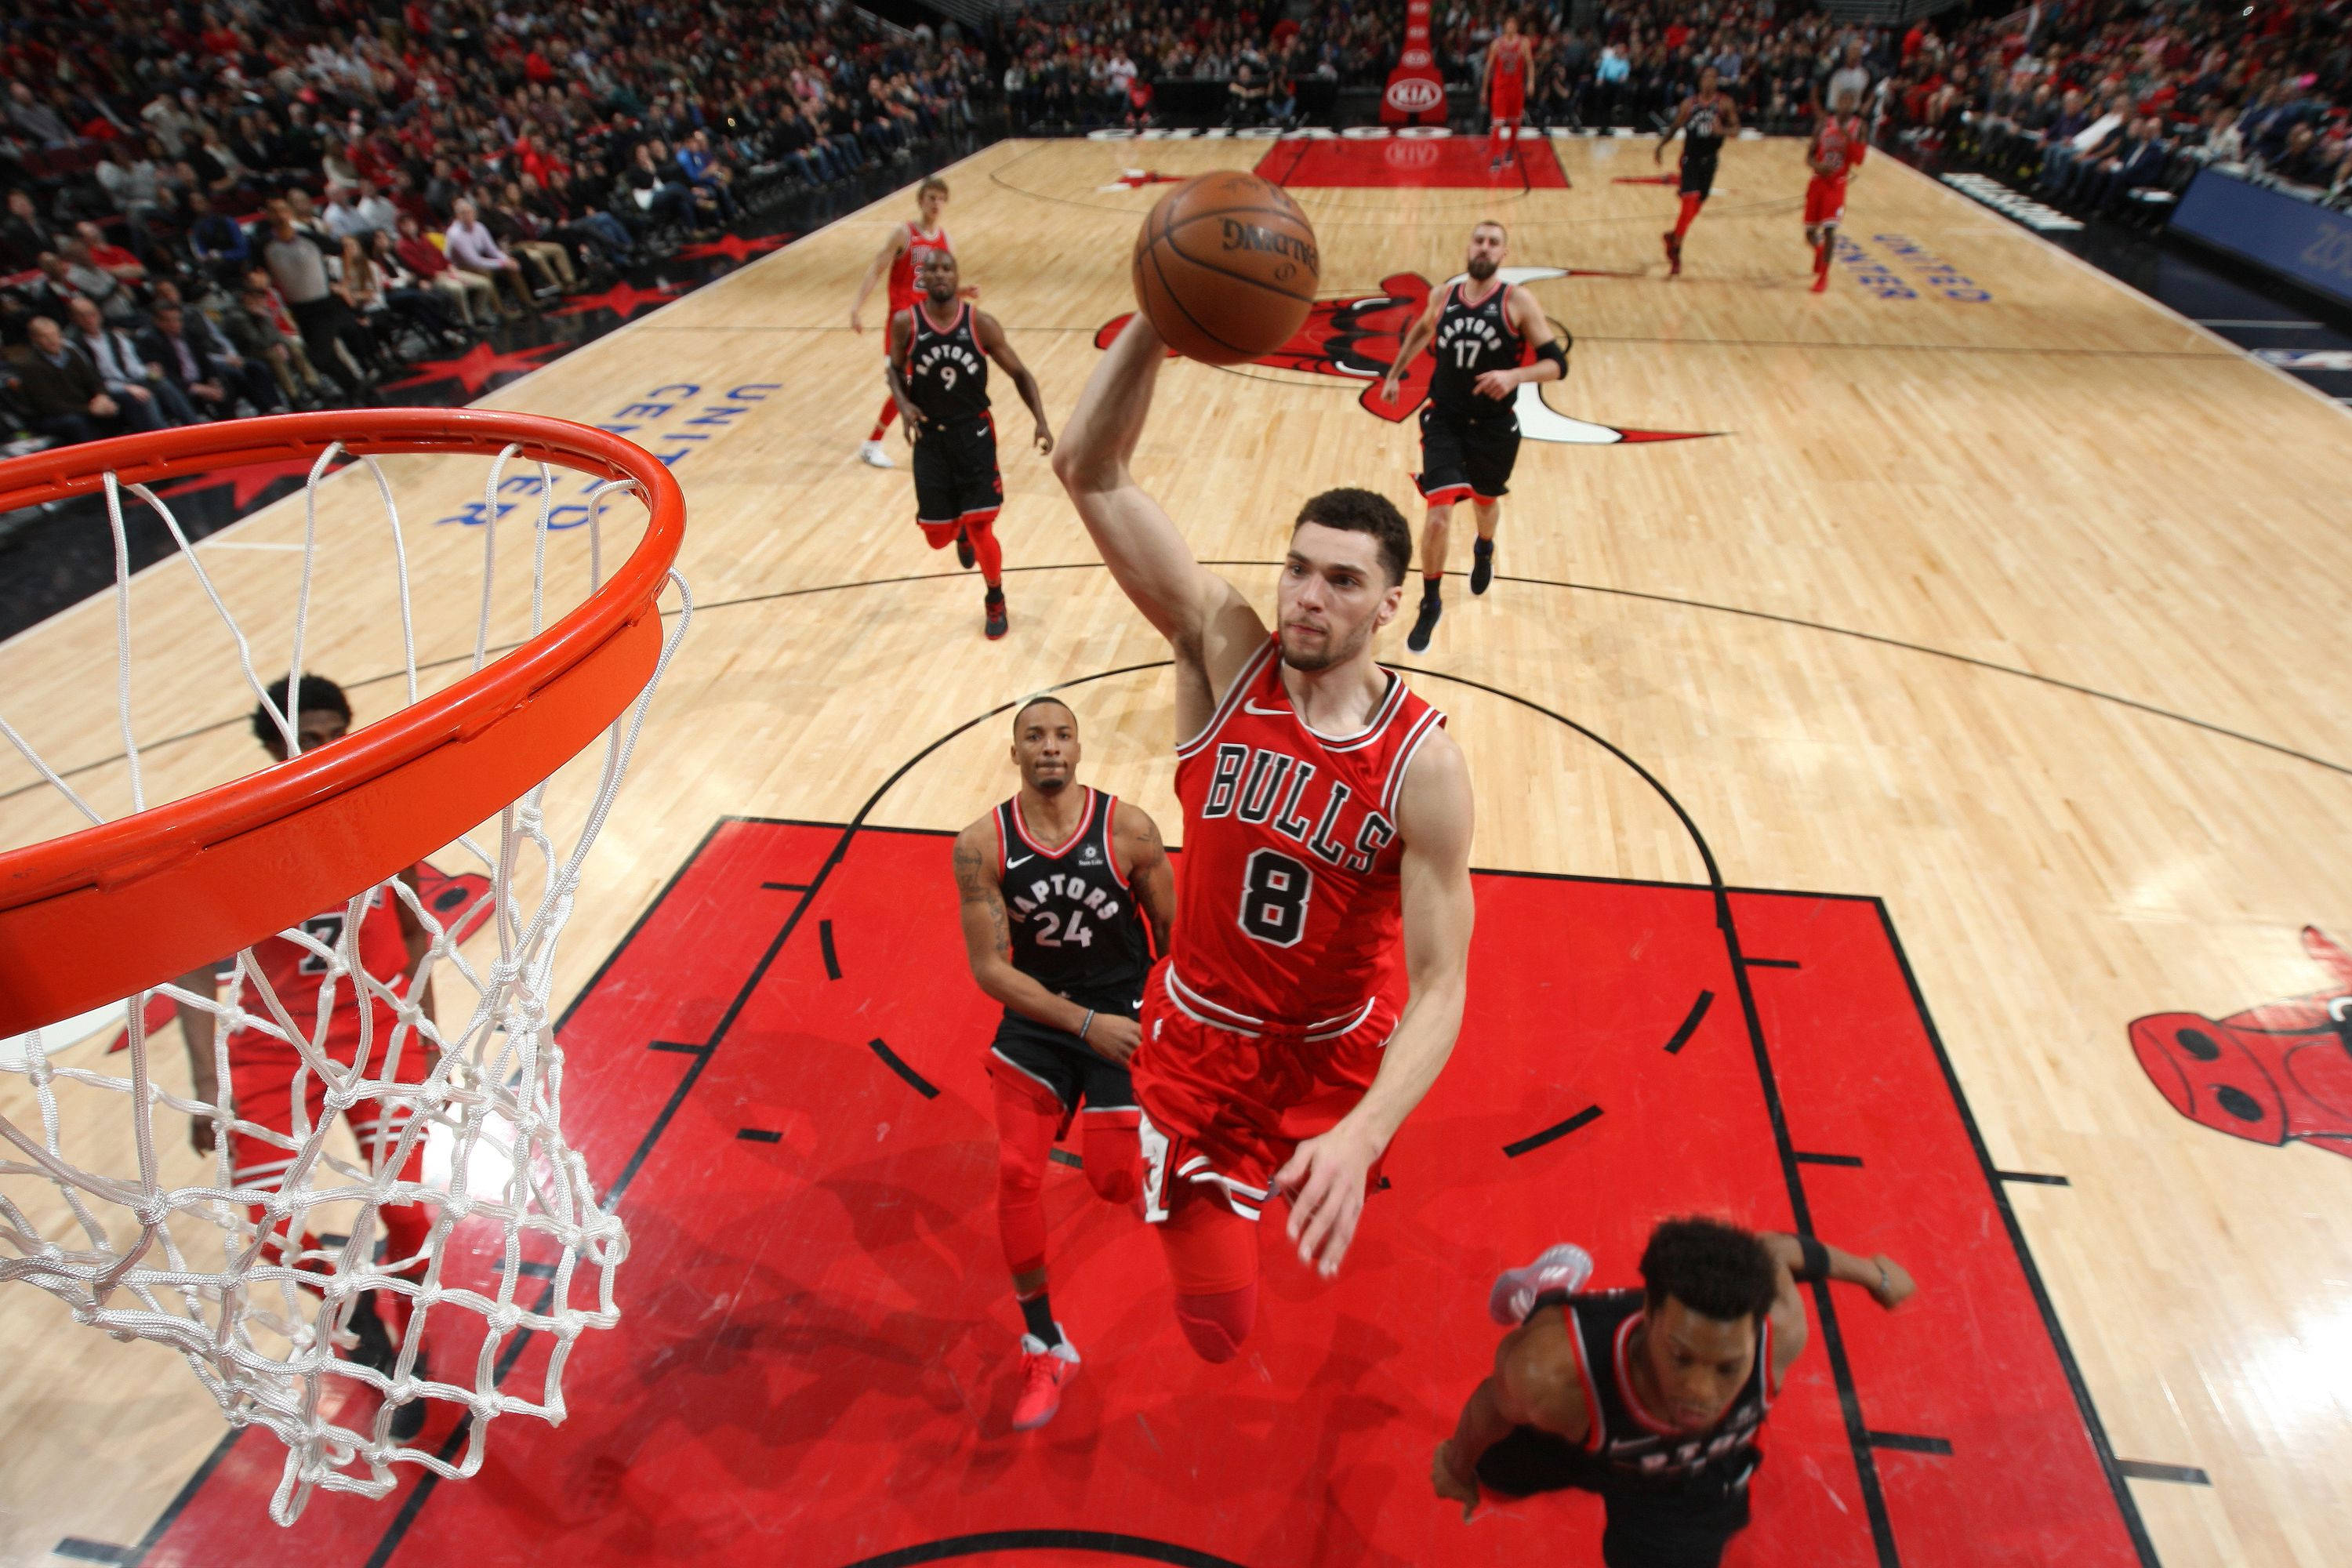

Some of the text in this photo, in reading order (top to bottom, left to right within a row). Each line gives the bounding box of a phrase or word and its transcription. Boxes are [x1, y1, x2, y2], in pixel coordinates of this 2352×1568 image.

[1392, 82, 1436, 103] KIA
[1437, 317, 1502, 350] RAPTORS
[916, 344, 979, 376] RAPTORS
[1454, 339, 1482, 369] 17
[941, 366, 956, 391] 9
[1202, 742, 1397, 875] BULLS
[1238, 847, 1314, 949] 8
[1033, 910, 1093, 948] 24
